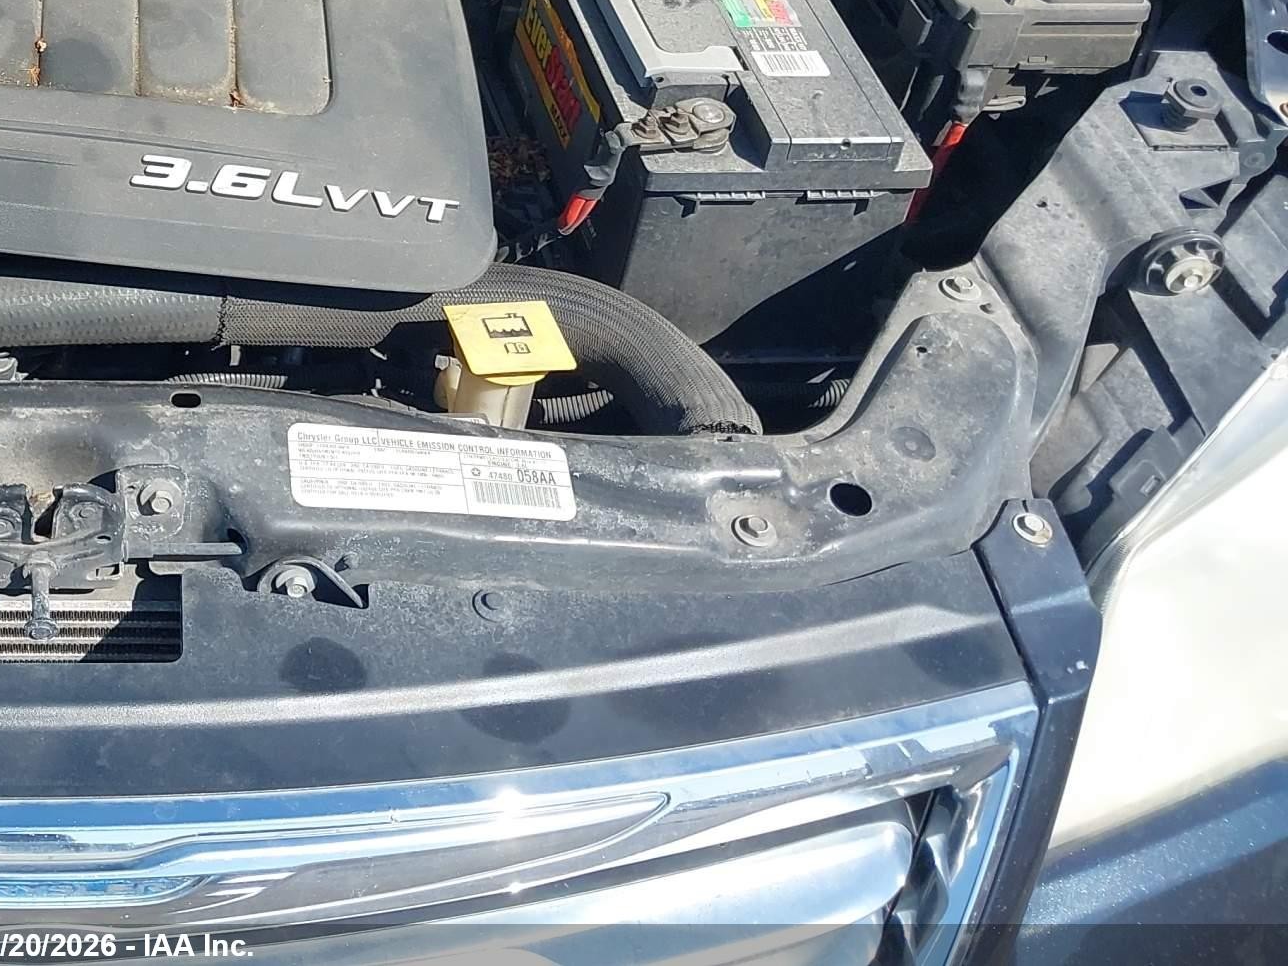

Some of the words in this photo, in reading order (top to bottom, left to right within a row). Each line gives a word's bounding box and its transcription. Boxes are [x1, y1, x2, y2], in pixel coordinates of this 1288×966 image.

[298, 432, 331, 442] Chrysler
[335, 435, 360, 445] Group
[362, 436, 378, 445] LLC
[381, 437, 414, 448] VEHICLE
[416, 440, 455, 451] EMISSION
[458, 443, 492, 454] CONTROL
[496, 448, 552, 459] INFORMATION
[517, 469, 557, 485] 058AA
